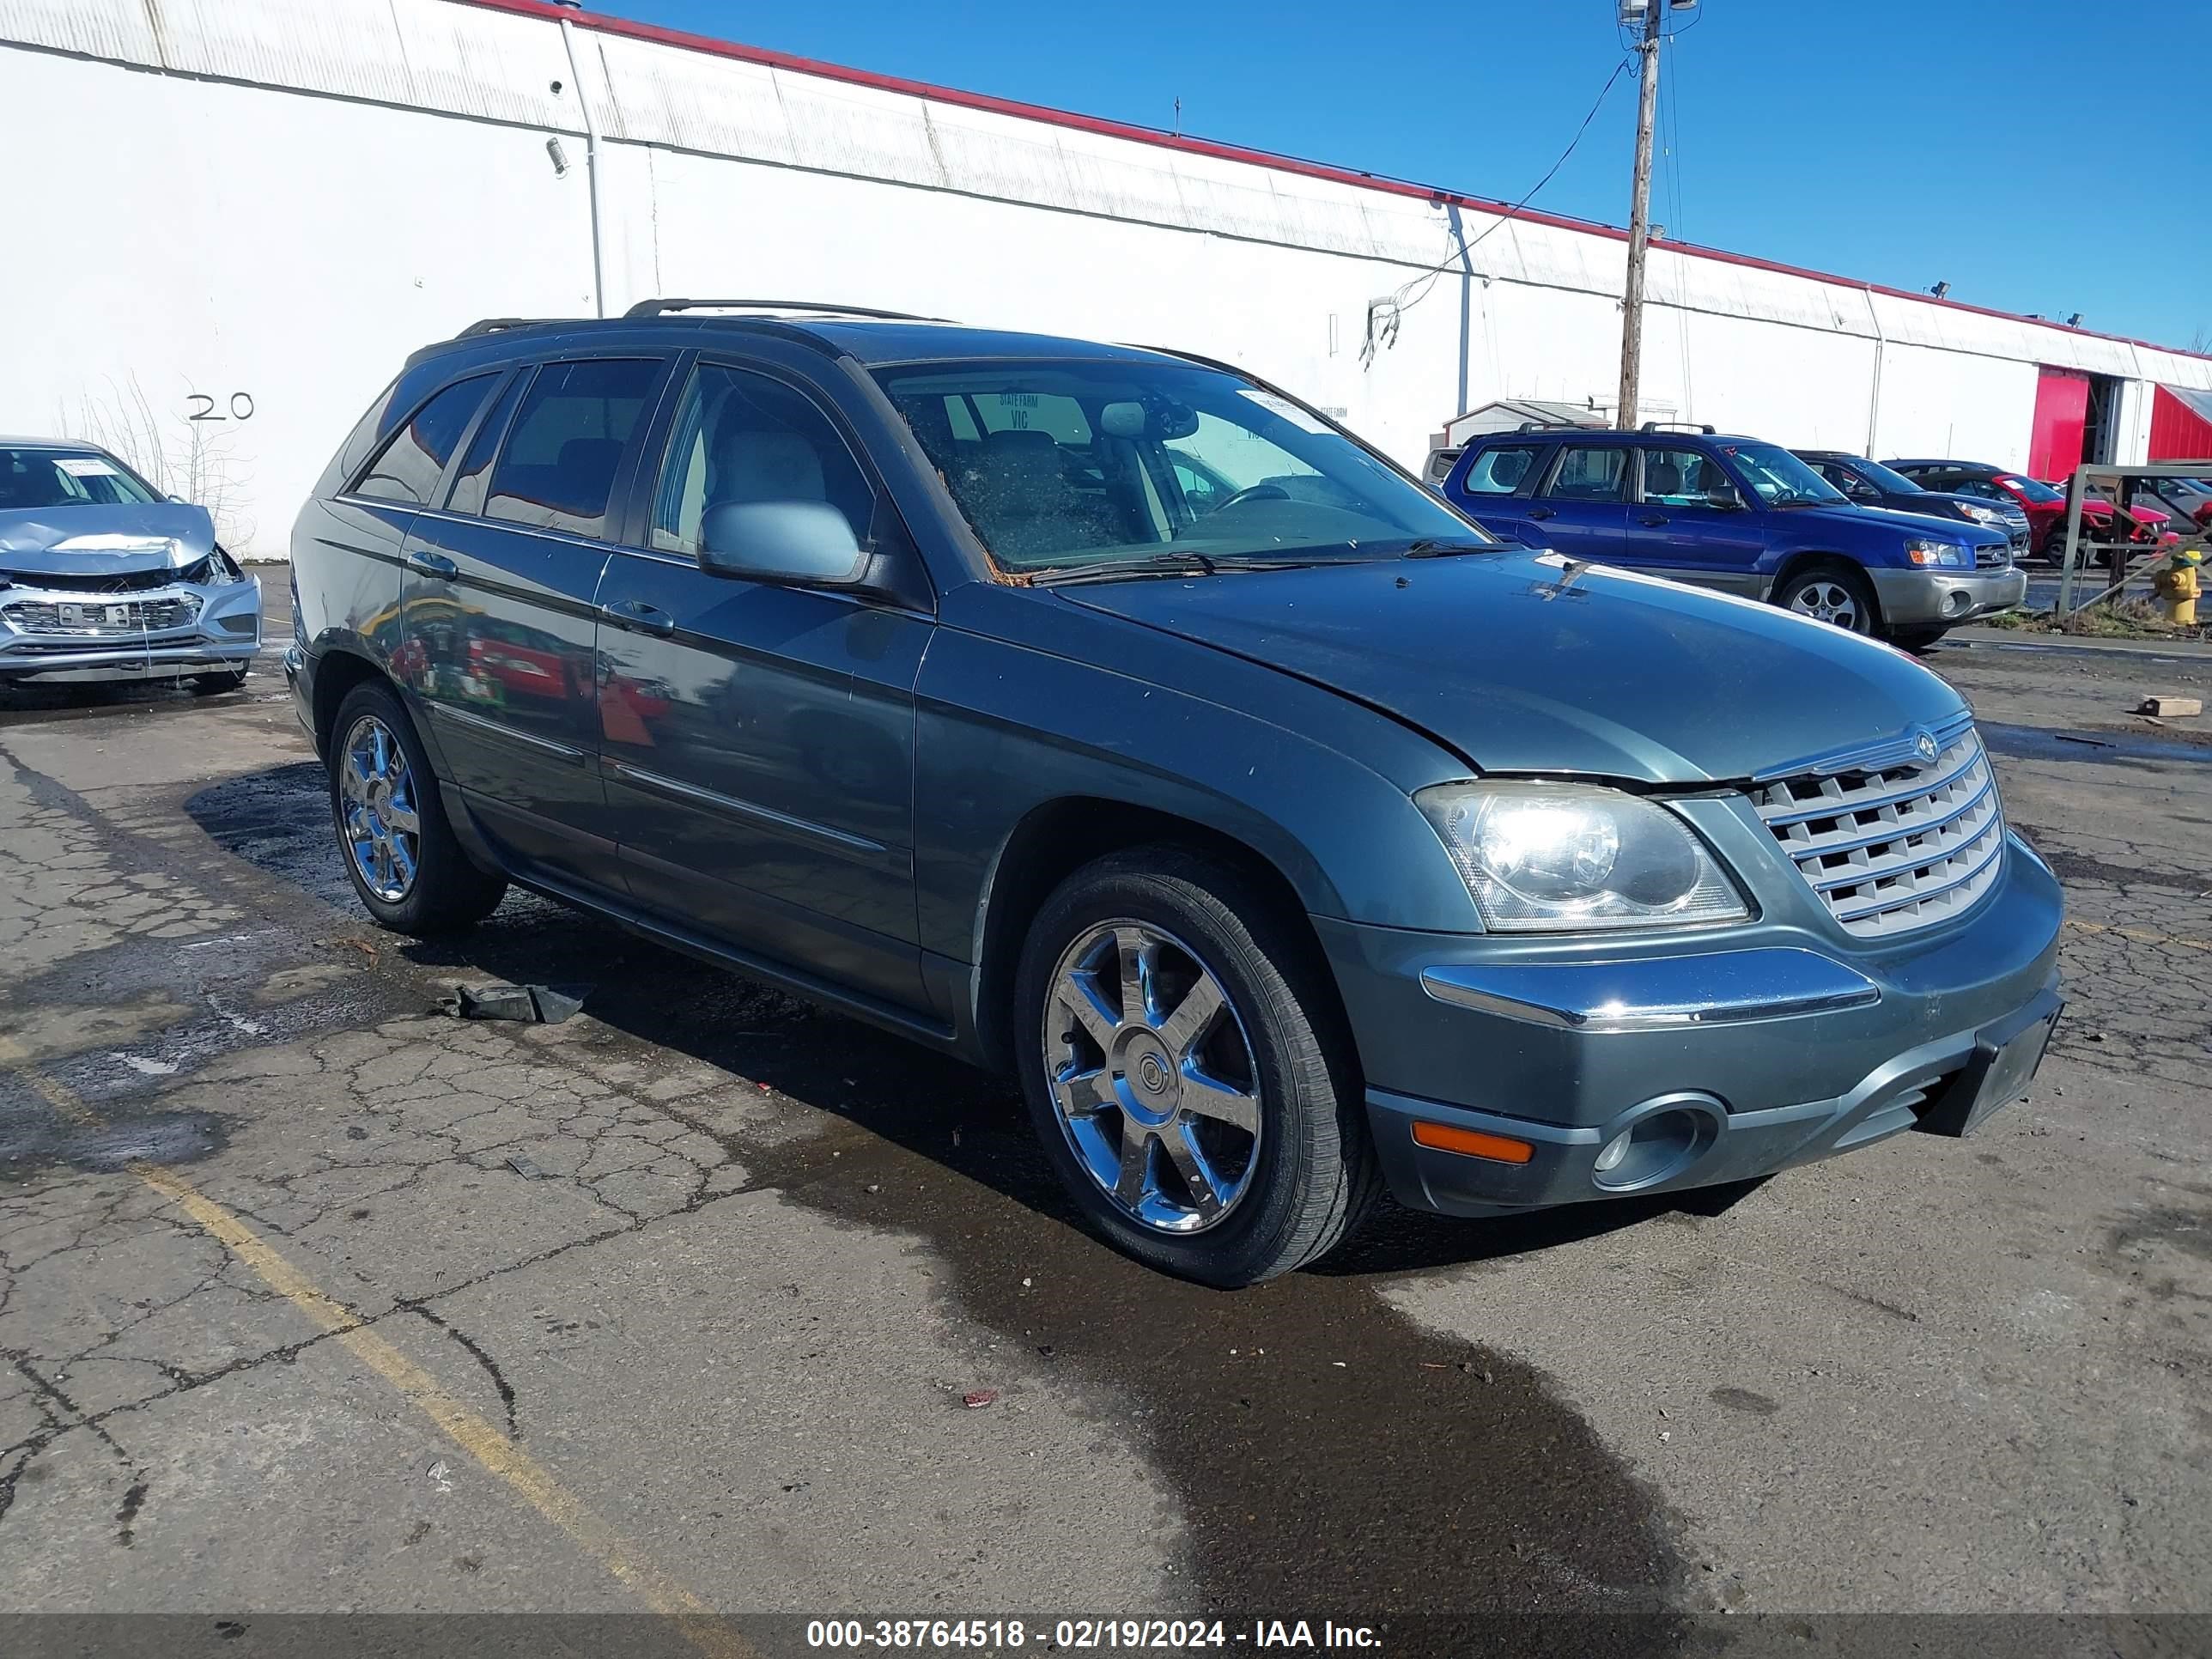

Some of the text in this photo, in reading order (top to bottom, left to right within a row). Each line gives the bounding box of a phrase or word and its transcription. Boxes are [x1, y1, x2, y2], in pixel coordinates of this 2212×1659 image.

[186, 392, 254, 420] 20
[1000, 392, 1038, 409] STATE FARM
[1011, 410, 1028, 429] VIC
[1334, 407, 1346, 418] FARM
